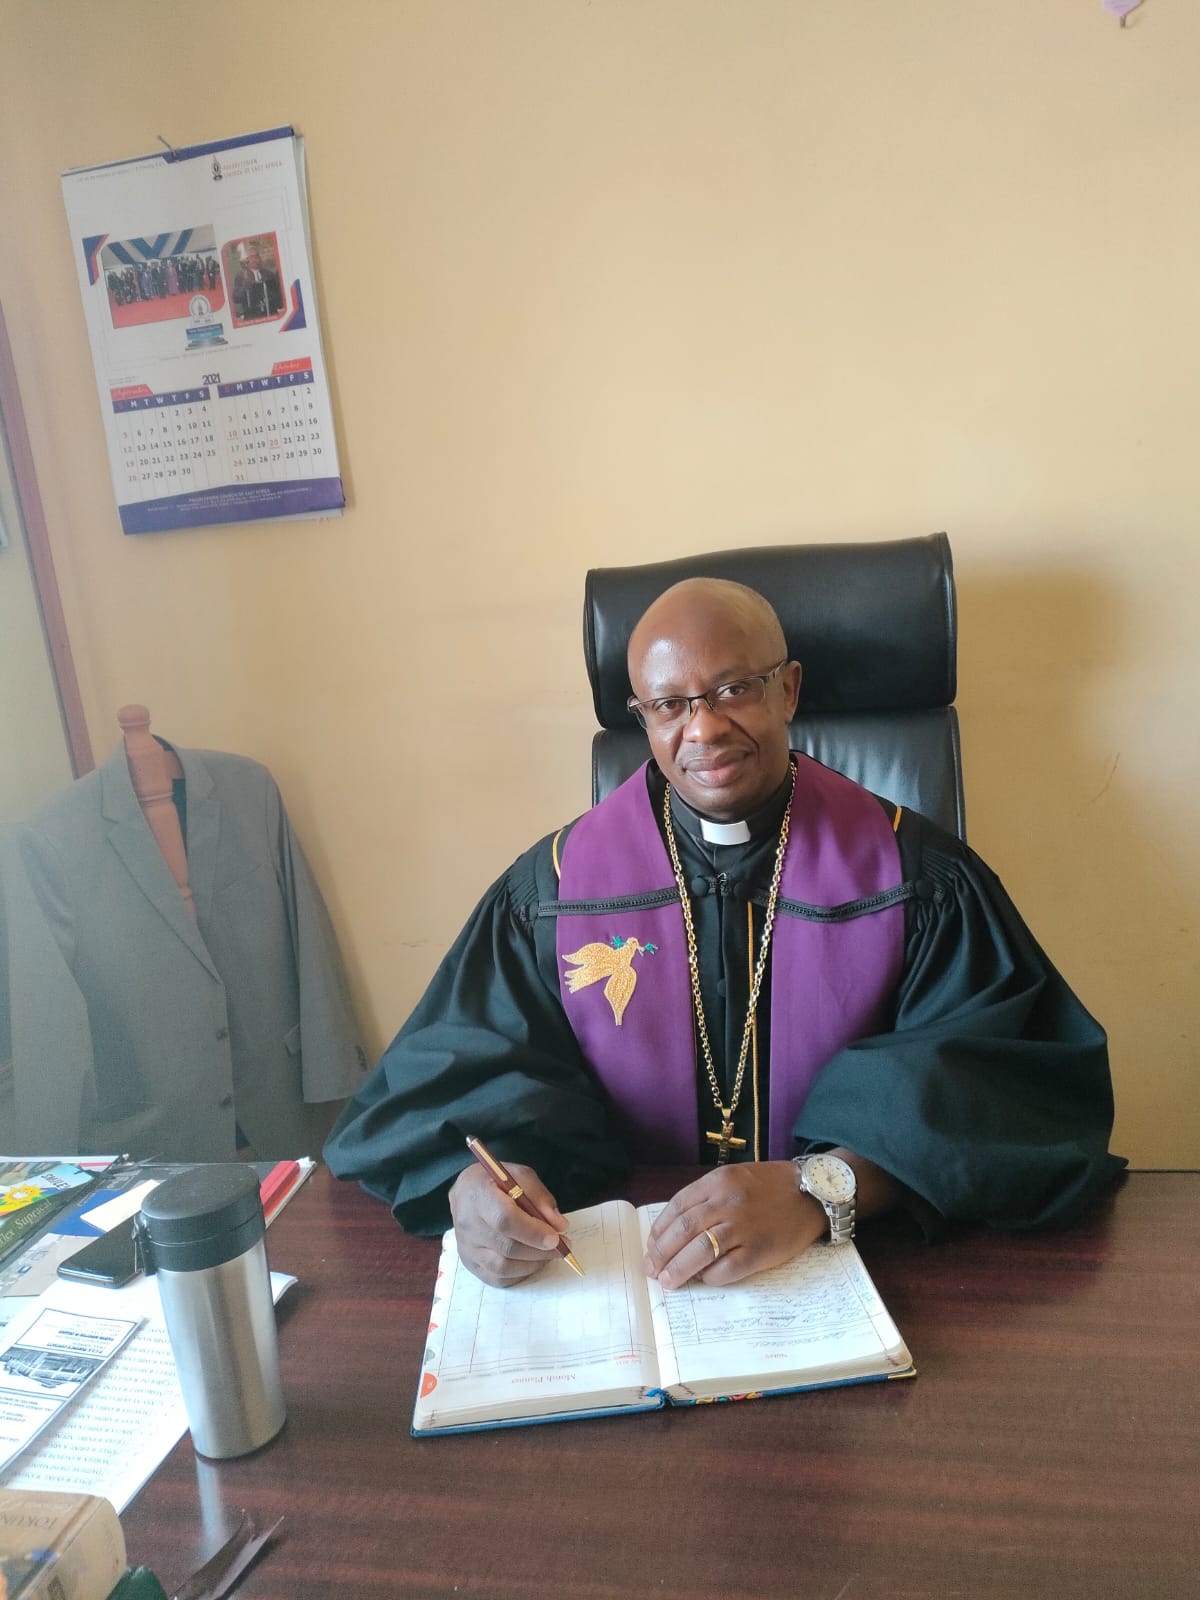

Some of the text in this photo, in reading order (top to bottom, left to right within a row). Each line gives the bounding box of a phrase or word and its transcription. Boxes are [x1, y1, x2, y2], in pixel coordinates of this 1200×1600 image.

[202, 373, 220, 386] 2021
[237, 383, 244, 391] M
[261, 379, 268, 387] W
[150, 428, 154, 436] 7
[242, 428, 252, 436] 11
[254, 426, 264, 434] 12
[268, 424, 277, 432] 13
[281, 422, 290, 430] 14
[294, 420, 304, 428] 15
[308, 418, 318, 426] 16
[137, 444, 146, 452] 13
[150, 442, 159, 450] 14
[177, 439, 186, 447] 16
[190, 437, 200, 445] 17
[204, 435, 214, 443] 18
[245, 443, 254, 451] 18
[257, 440, 266, 449] 19
[270, 439, 279, 447] 20
[284, 436, 292, 445] 21
[296, 434, 306, 442] 22
[311, 432, 320, 440] 23
[152, 457, 161, 465] 21
[260, 456, 268, 464] 26
[286, 452, 295, 460] 28
[298, 450, 308, 458] 29
[154, 471, 164, 479] 28
[168, 470, 177, 478] 29
[182, 468, 191, 476] 30
